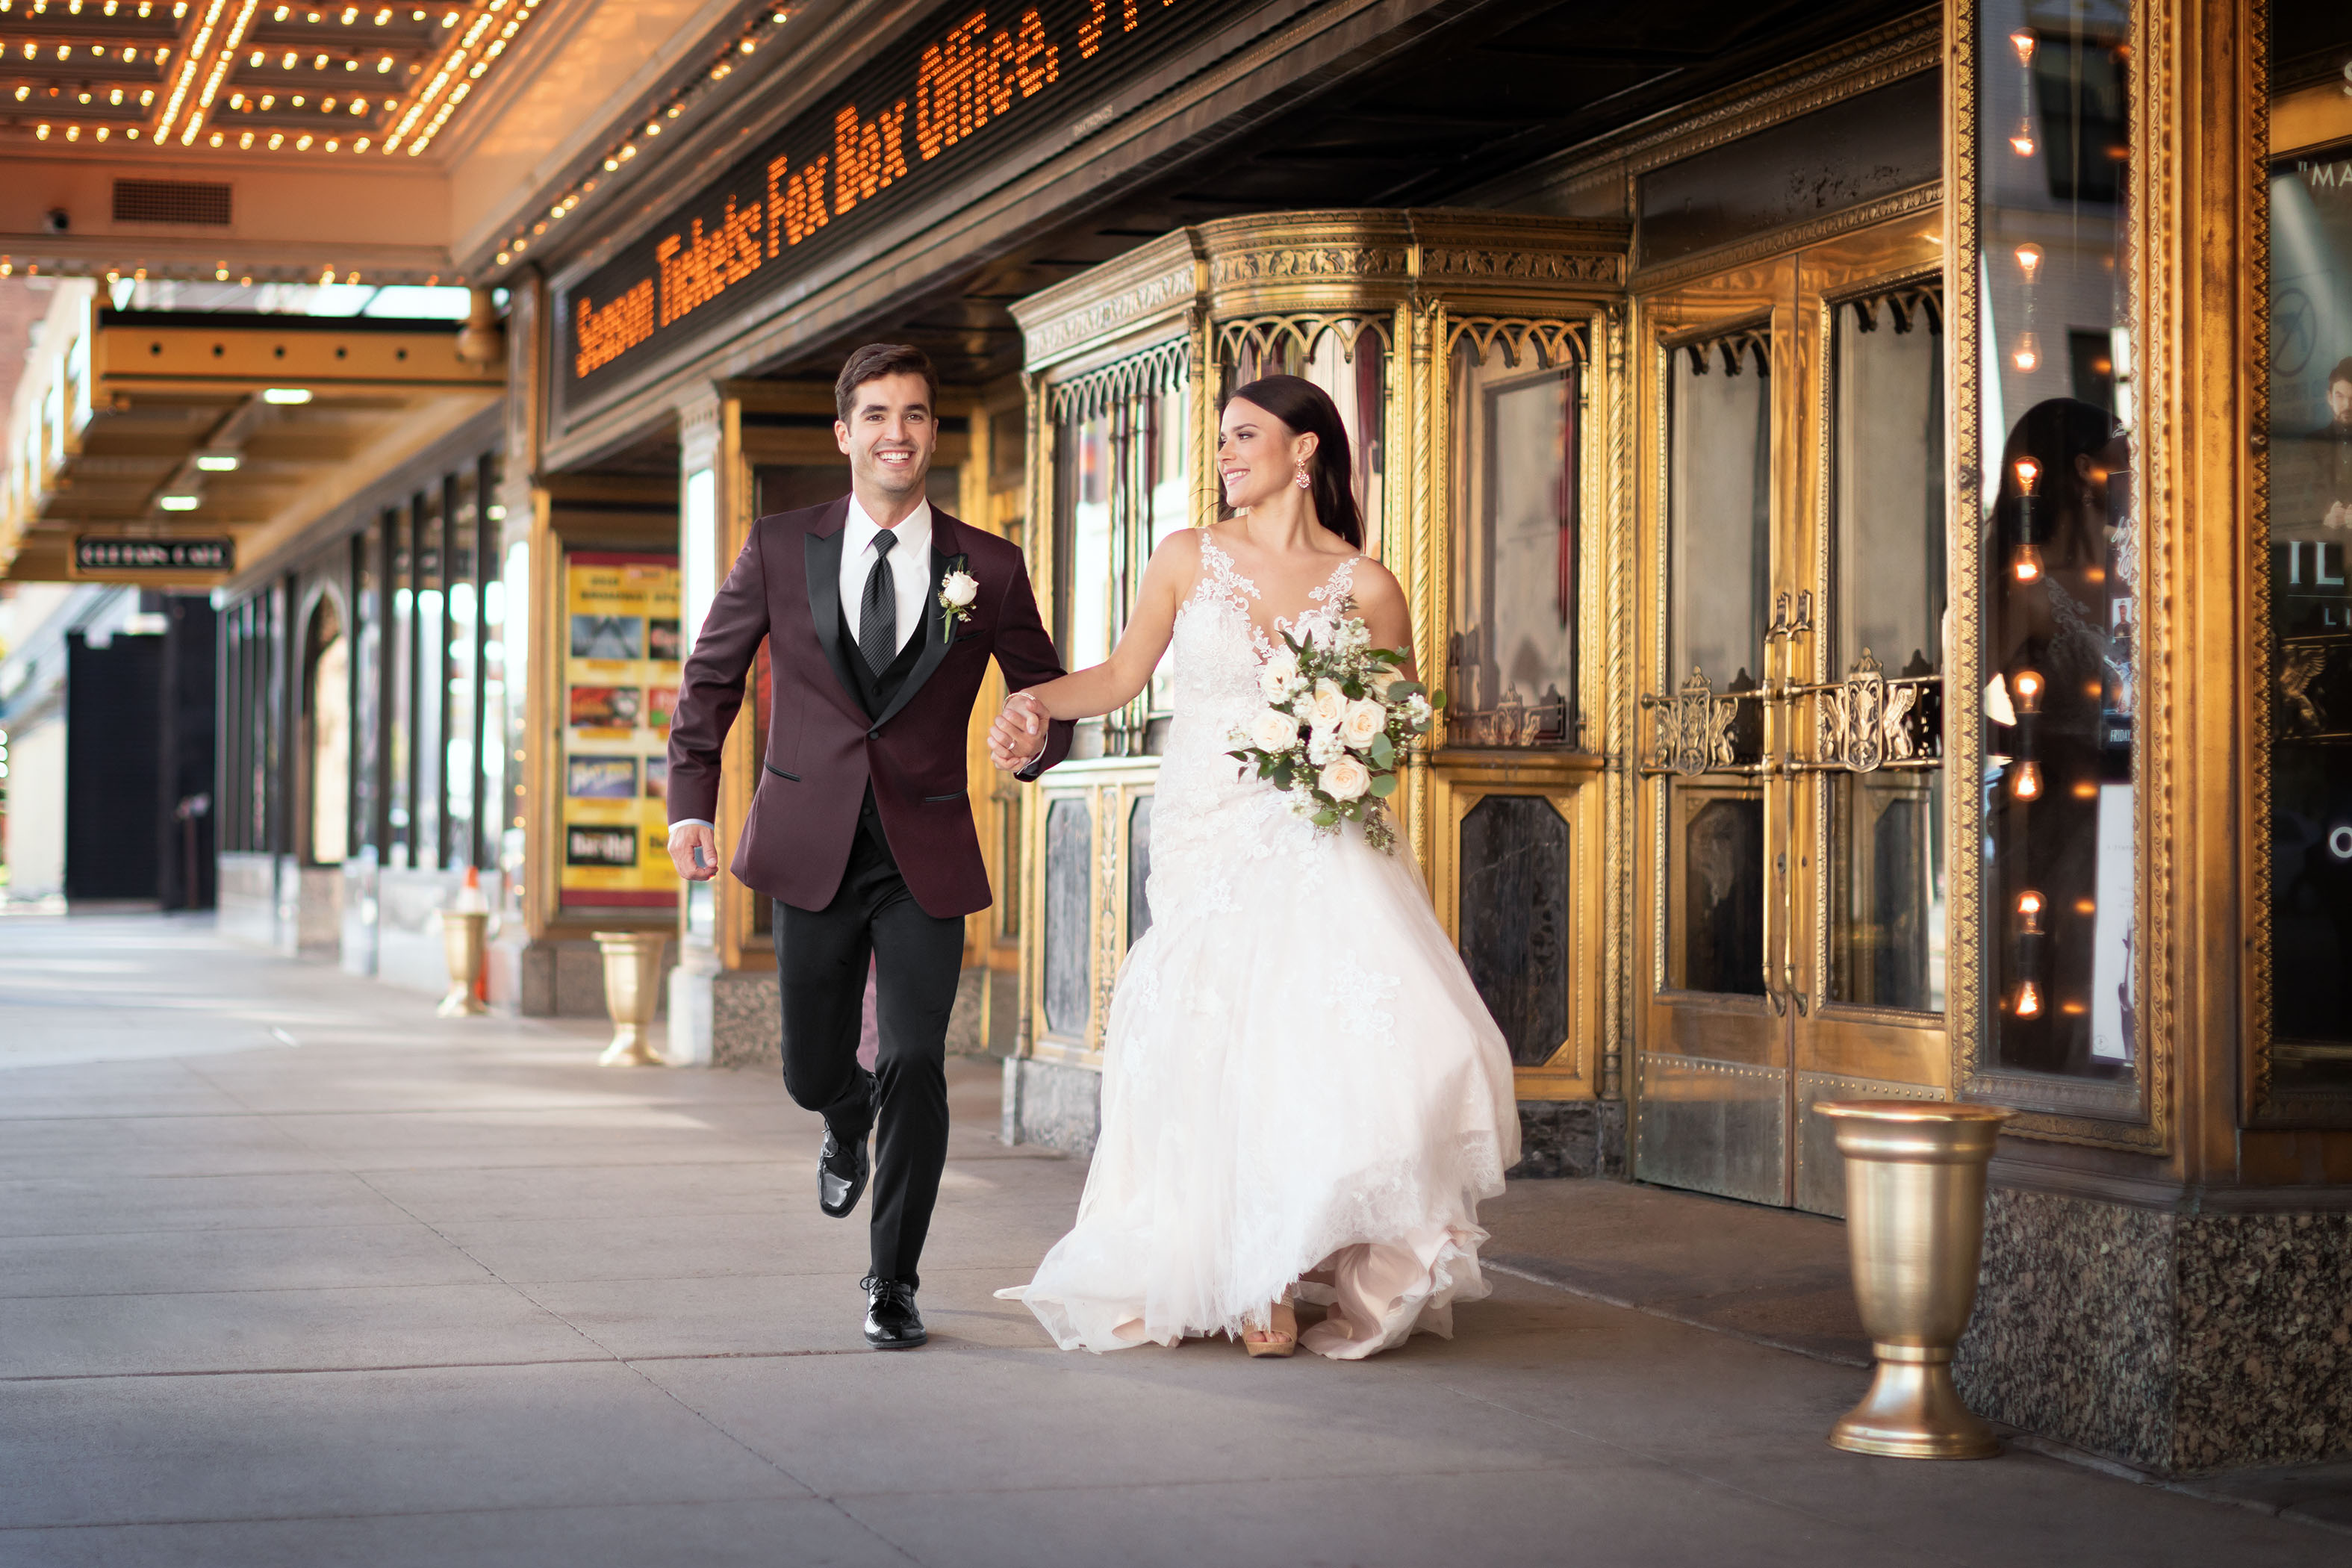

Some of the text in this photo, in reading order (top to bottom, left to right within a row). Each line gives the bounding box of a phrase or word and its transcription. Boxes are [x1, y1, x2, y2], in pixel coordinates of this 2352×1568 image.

[576, 279, 654, 378] Season
[657, 194, 762, 327] Tickets
[768, 156, 829, 258] Fox
[835, 102, 908, 215] Box
